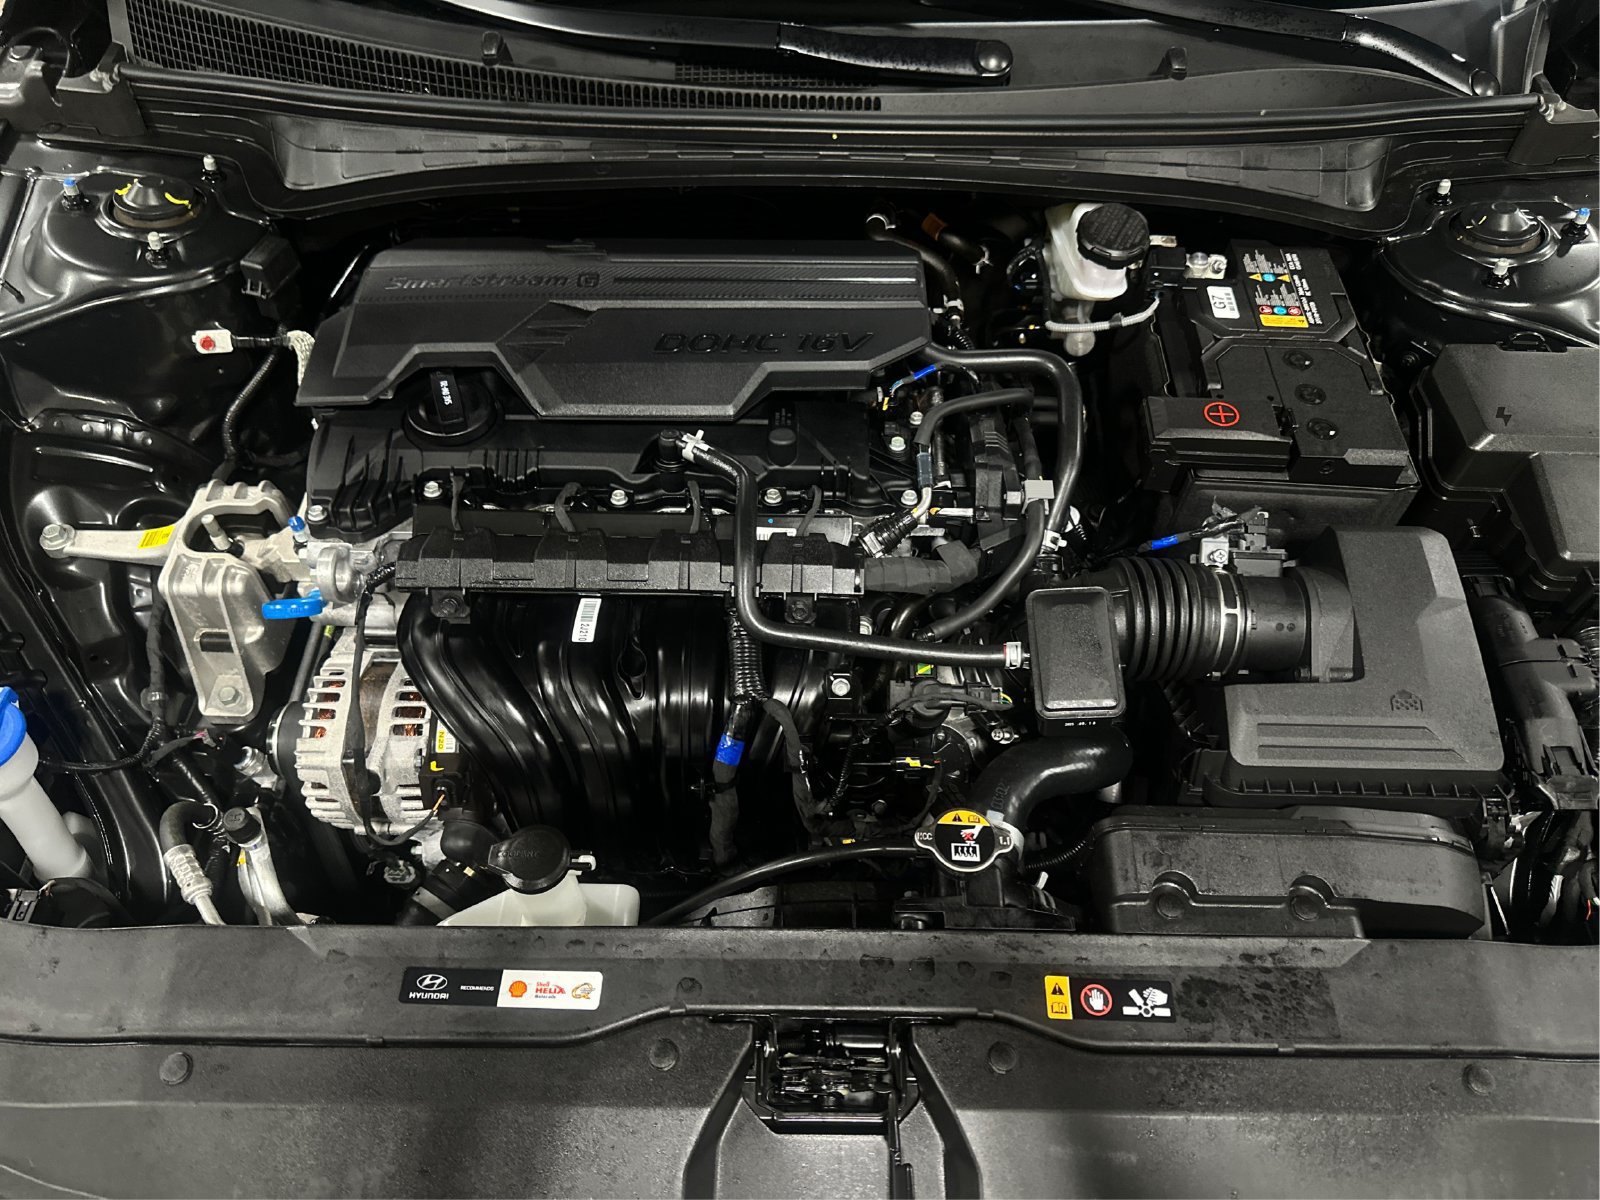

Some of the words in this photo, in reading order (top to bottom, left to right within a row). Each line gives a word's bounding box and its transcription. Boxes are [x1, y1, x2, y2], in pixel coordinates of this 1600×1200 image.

[384, 273, 569, 290] Smartstream
[652, 333, 787, 353] DOHC
[797, 332, 874, 352] 16V
[408, 991, 450, 1000] HYUNDAI
[535, 984, 566, 994] HELIX
